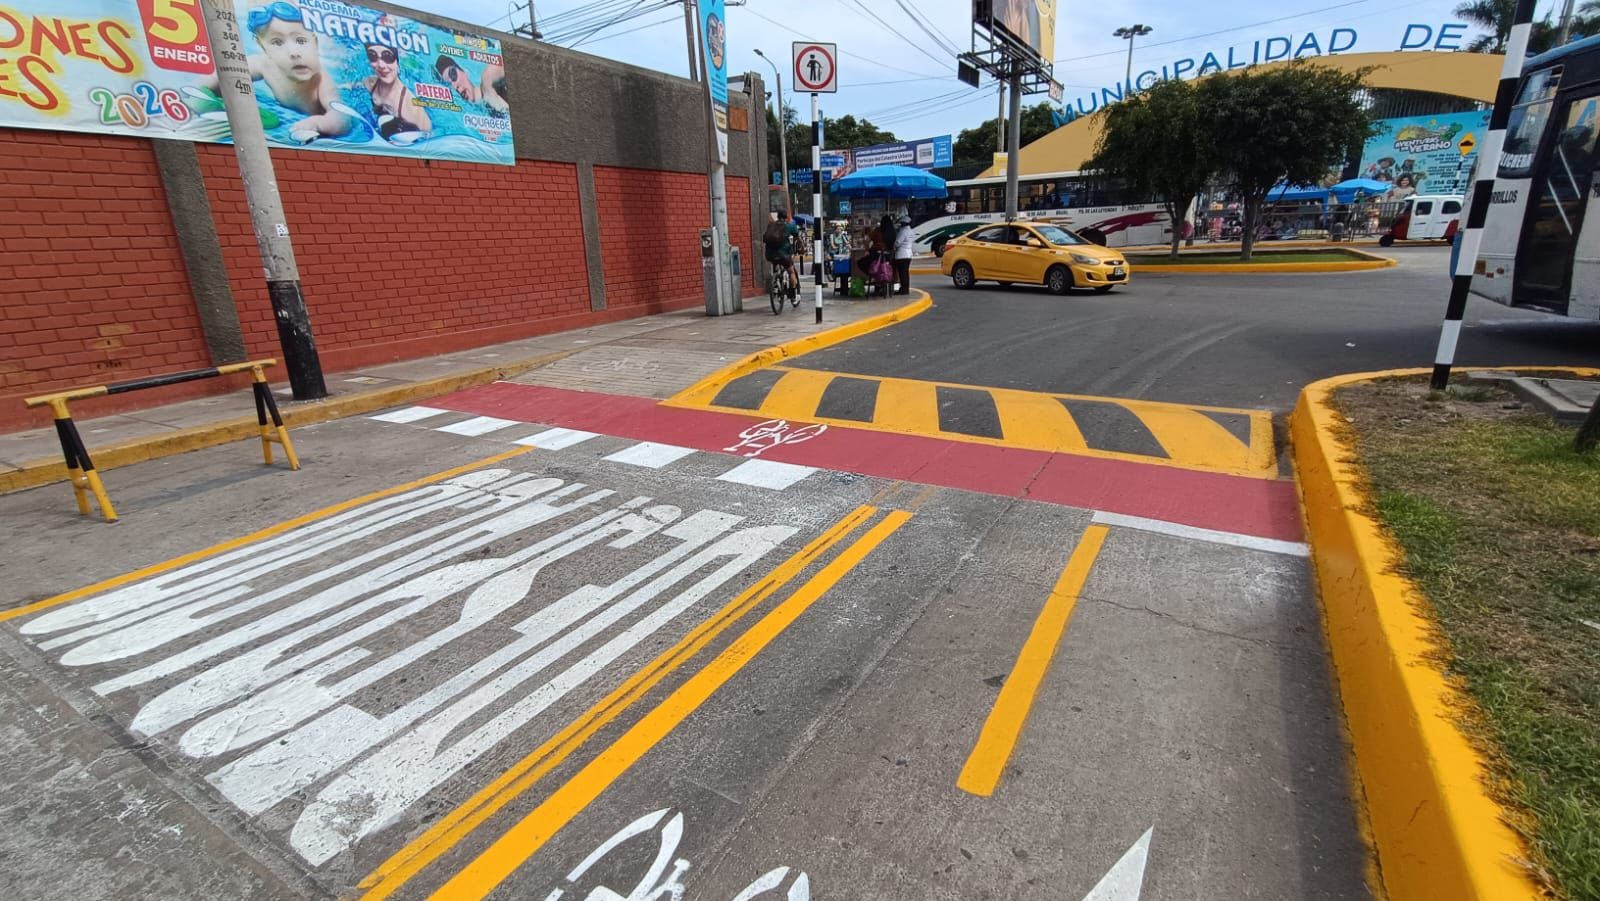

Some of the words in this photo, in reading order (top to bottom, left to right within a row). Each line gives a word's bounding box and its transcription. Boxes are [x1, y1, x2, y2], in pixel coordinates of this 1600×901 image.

[148, 0, 198, 45] 5
[301, 7, 430, 54] NATACIÓN
[153, 45, 211, 65] ENERO
[194, 44, 208, 53] DE
[1051, 27, 1358, 128] MUNICIPALIDAD
[1399, 23, 1469, 51] DE
[89, 80, 190, 128] 2026
[415, 83, 452, 101] PATERA
[1395, 136, 1440, 149] AVENTURAS
[1409, 141, 1451, 153] VERANO
[19, 468, 800, 868] DESPACIO
